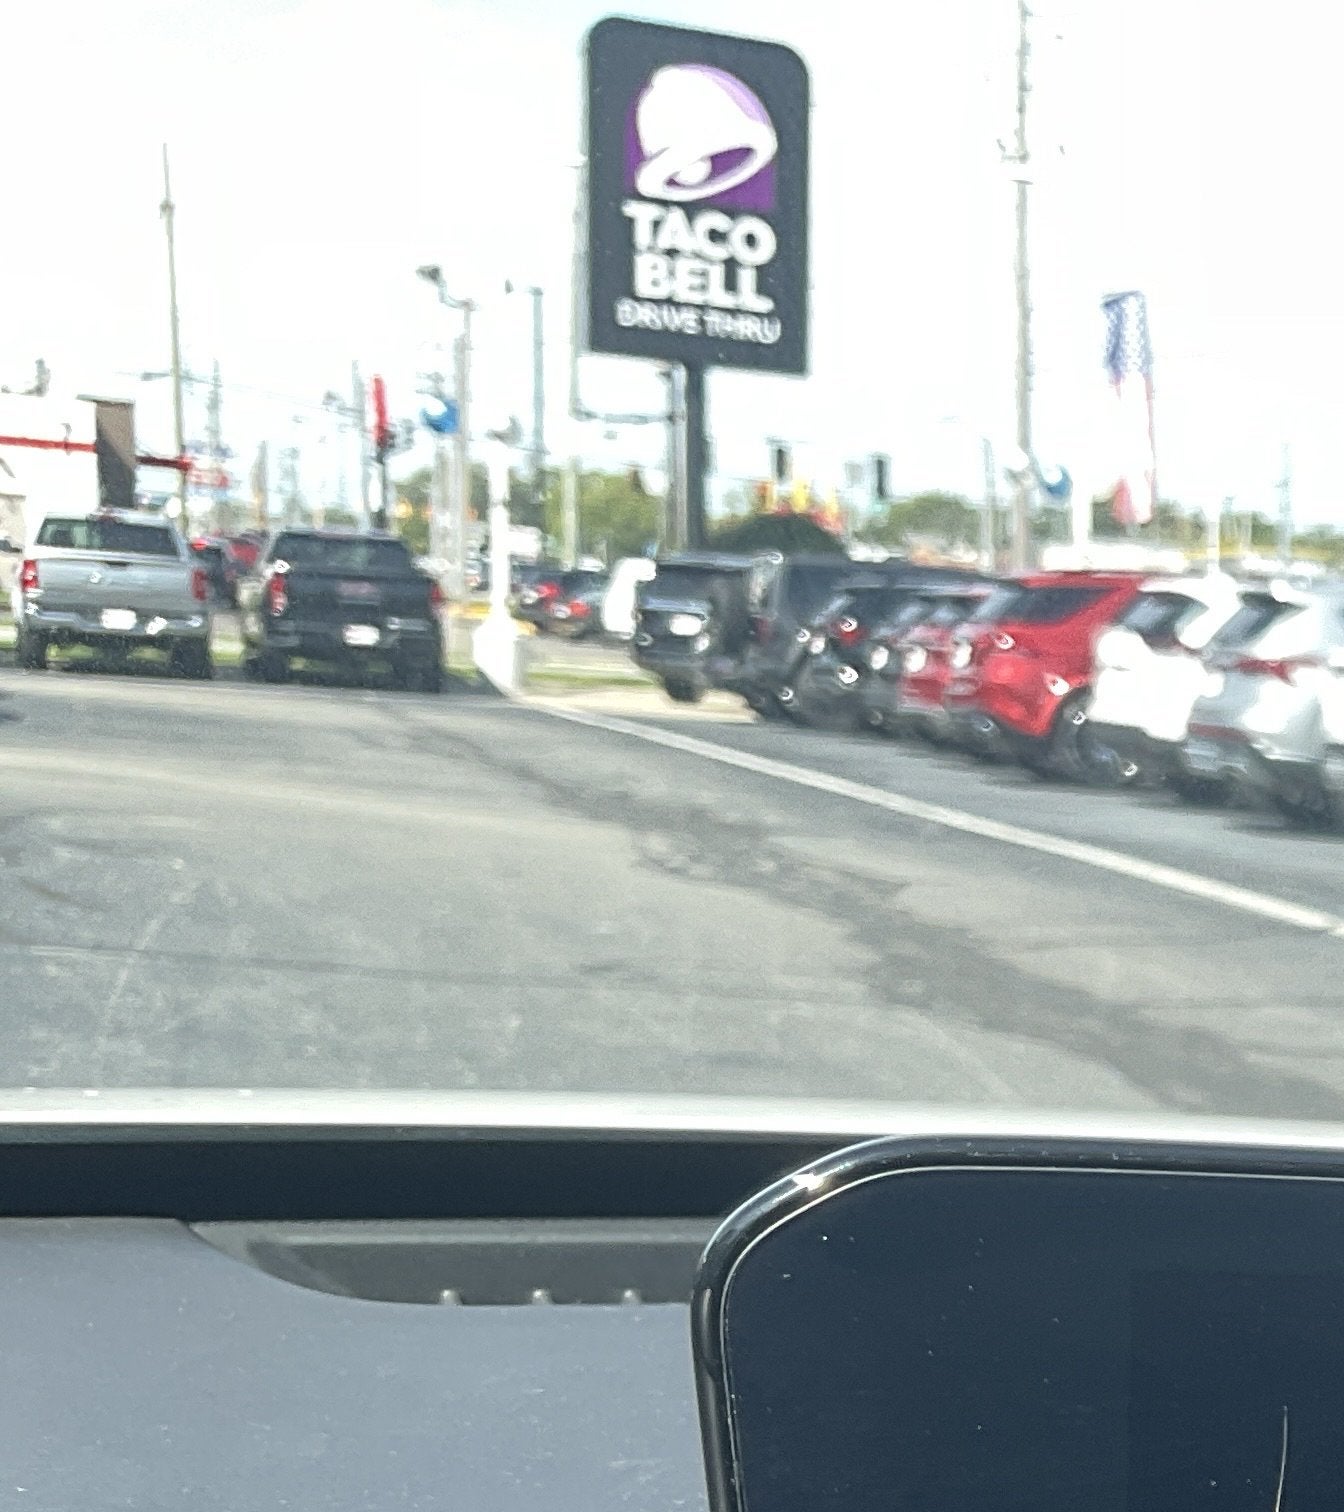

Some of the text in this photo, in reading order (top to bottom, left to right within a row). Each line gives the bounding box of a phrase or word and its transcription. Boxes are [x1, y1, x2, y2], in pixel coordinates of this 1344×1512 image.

[621, 199, 777, 267] TACO
[633, 251, 775, 313] BELL
[615, 297, 782, 345] DRIVE THRU
